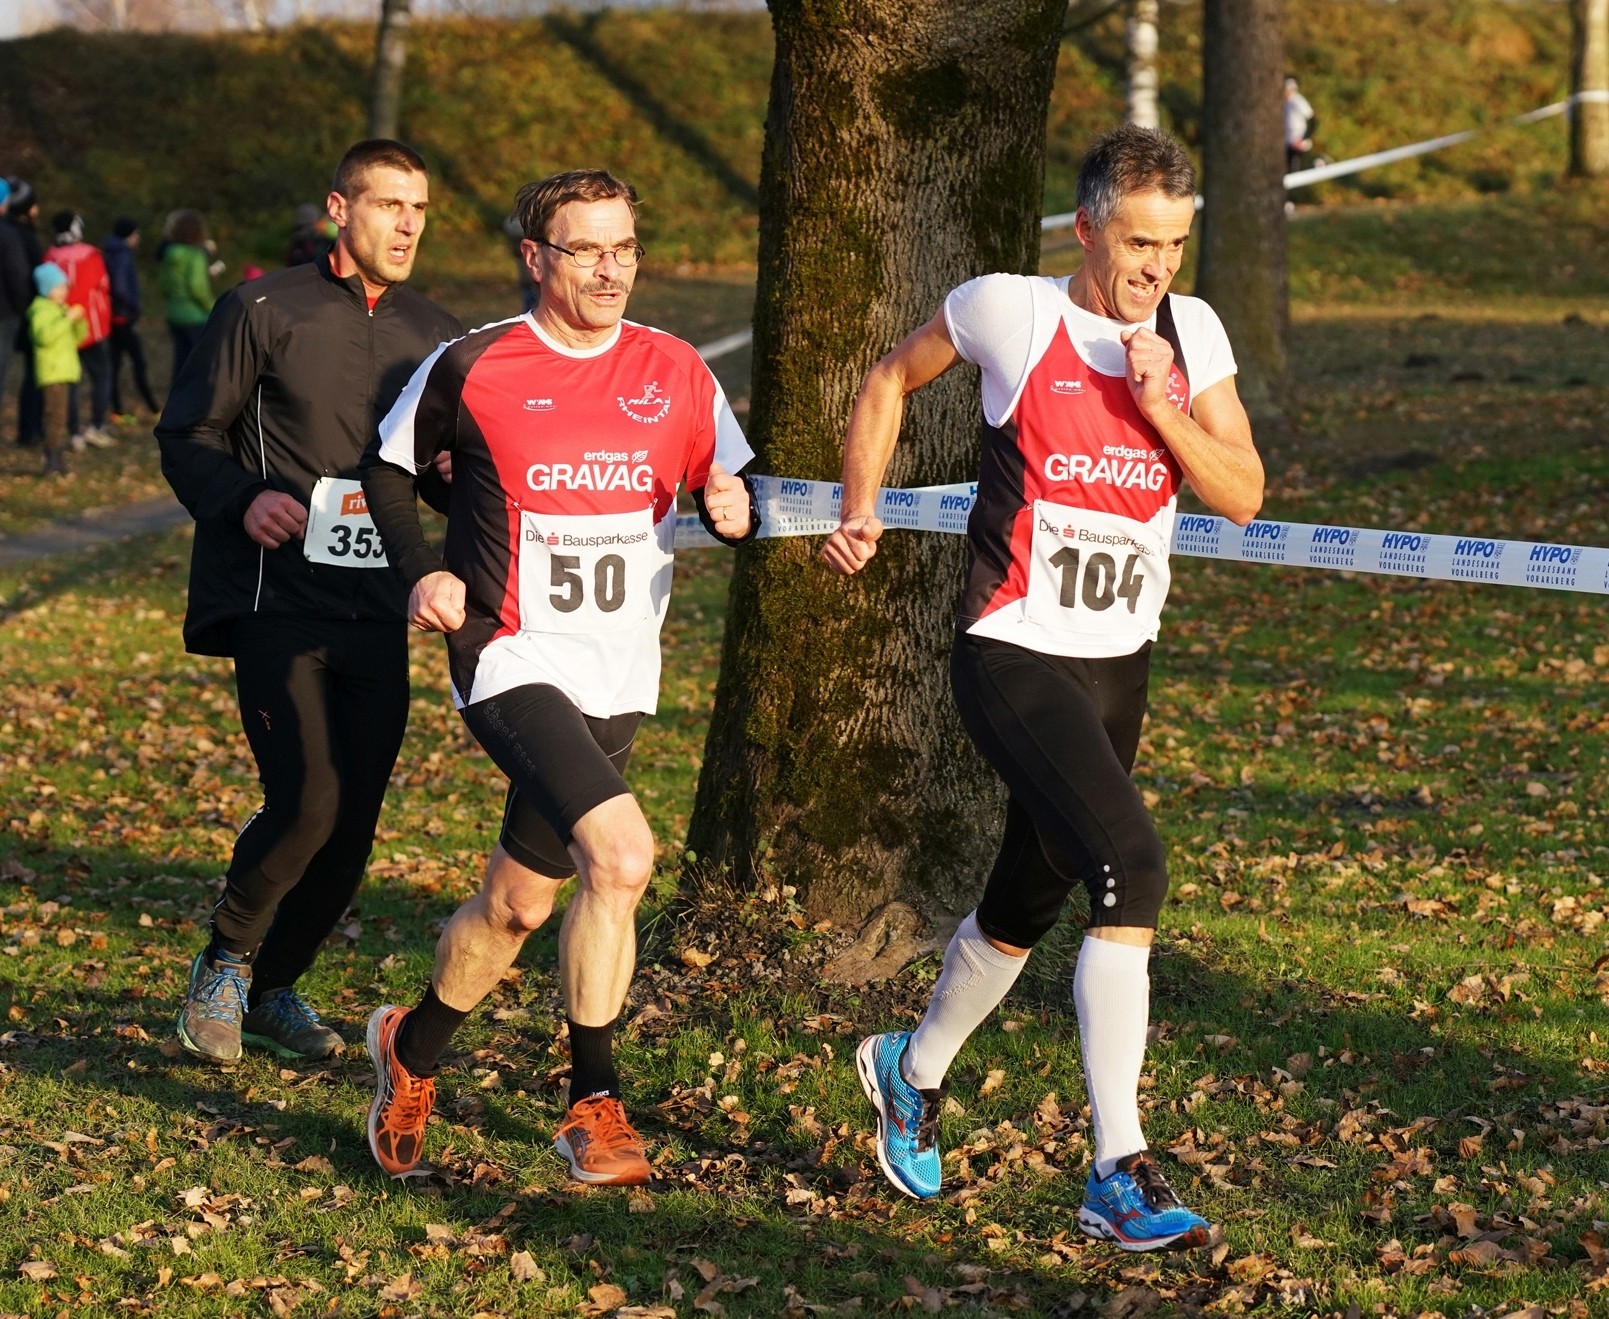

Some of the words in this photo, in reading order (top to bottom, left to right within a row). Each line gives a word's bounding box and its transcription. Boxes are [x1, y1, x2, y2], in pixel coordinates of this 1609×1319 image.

[617, 395, 671, 424] RHEINTAL
[584, 450, 628, 464] erdgas
[1103, 445, 1147, 461] erdgas
[526, 463, 654, 492] GRAVAG
[1044, 453, 1168, 492] GRAVAG
[781, 480, 807, 496] HYPO
[885, 491, 914, 507] HYPO
[940, 495, 970, 511] HYPO
[1039, 518, 1060, 536] Die
[1180, 516, 1215, 534] HYPO
[1245, 523, 1281, 540] HYPO
[327, 524, 385, 559] 353
[525, 529, 545, 544] Die
[563, 532, 648, 548] Bausparkasse
[1312, 528, 1350, 545] HYPO
[1382, 533, 1421, 552] HYPO
[1242, 540, 1286, 551] LANDESBANK
[1310, 546, 1355, 556] LANDESBANK
[1454, 540, 1495, 558] HYPO
[1242, 549, 1285, 561] VORARLBERG
[1309, 555, 1354, 566] VORARLBERG
[1379, 551, 1426, 563] LANDESBANK
[1529, 546, 1572, 564] HYPO
[1379, 561, 1425, 573] VORARLBERG
[1452, 558, 1500, 569] LANDESBANK
[1527, 564, 1577, 575] LANDESBANK
[1048, 546, 1145, 615] 104
[1451, 568, 1500, 580] VORARLBERG
[1526, 574, 1576, 586] VORARLBERG
[549, 553, 626, 613] 50
